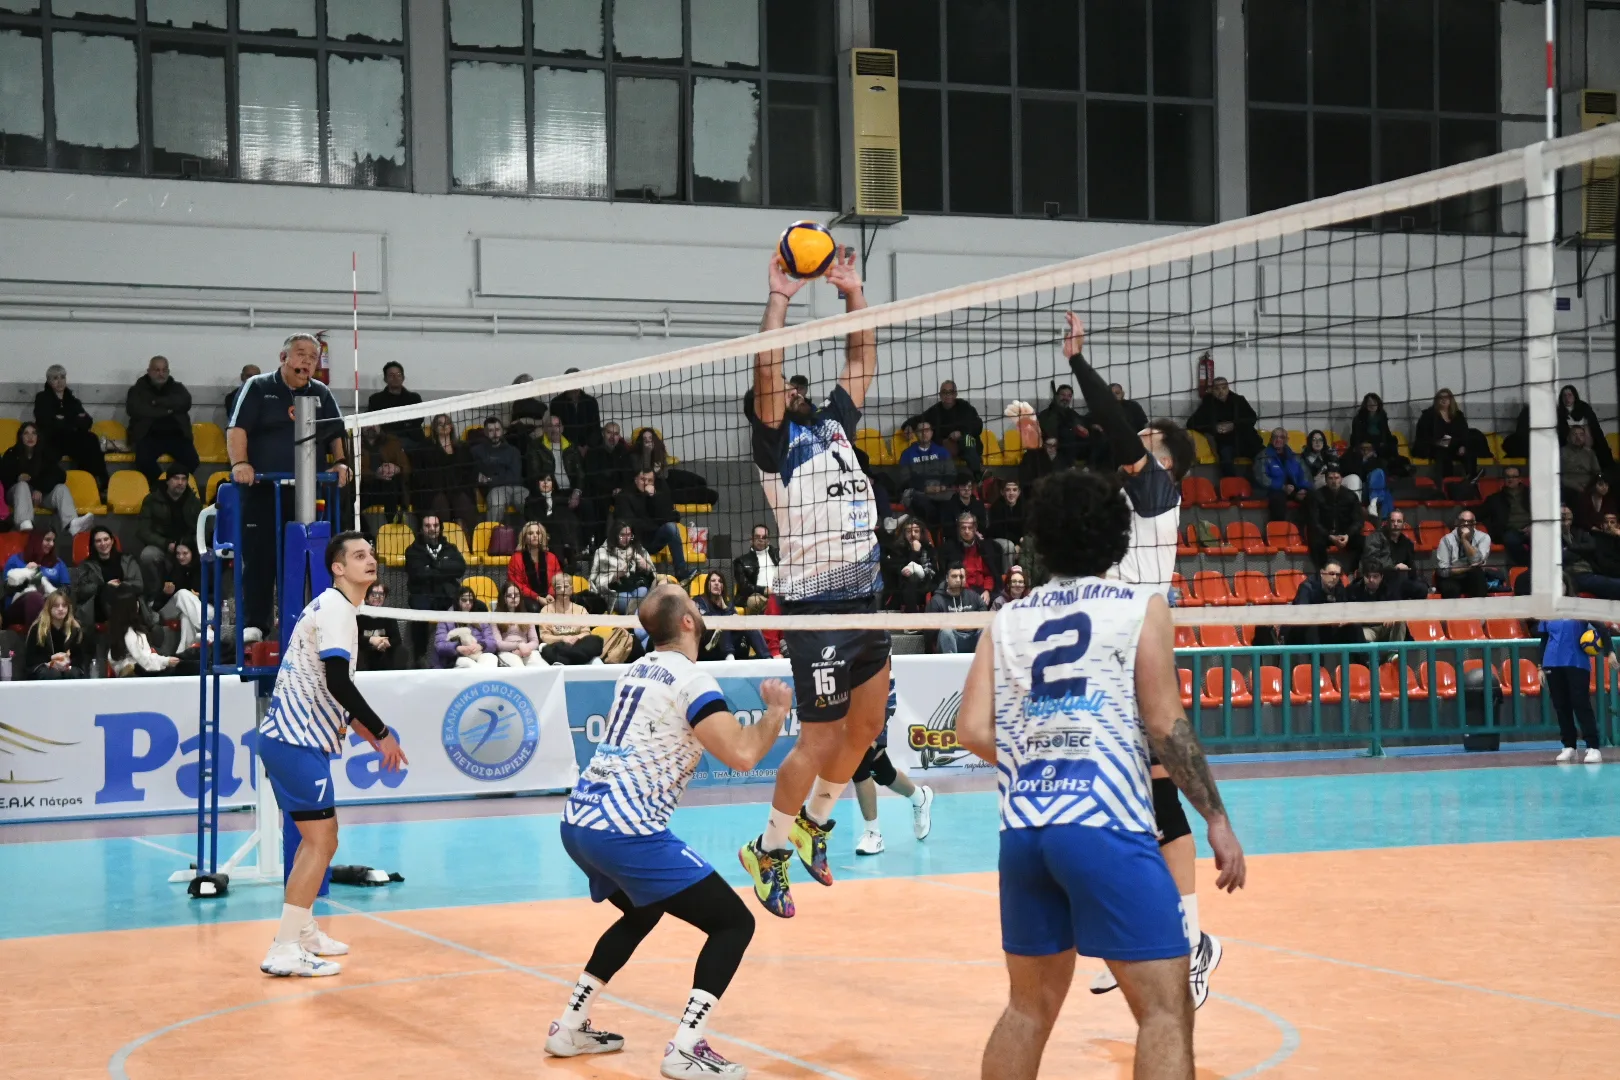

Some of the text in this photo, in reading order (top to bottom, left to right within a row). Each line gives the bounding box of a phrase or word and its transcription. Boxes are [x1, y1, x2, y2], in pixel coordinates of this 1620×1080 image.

[1031, 611, 1092, 702] 2
[812, 668, 836, 695] 15
[445, 688, 479, 740] ΕΛΛΗΝΙΚΗ
[482, 684, 536, 736] ΟΜΟΣΠΟΝΔΙΑ
[606, 684, 646, 746] 11
[452, 747, 531, 776] ΠΕΤΟΣΦΑΙΡΙΣΗΣ
[40, 797, 83, 807] Πάτρας
[315, 778, 327, 801] 7
